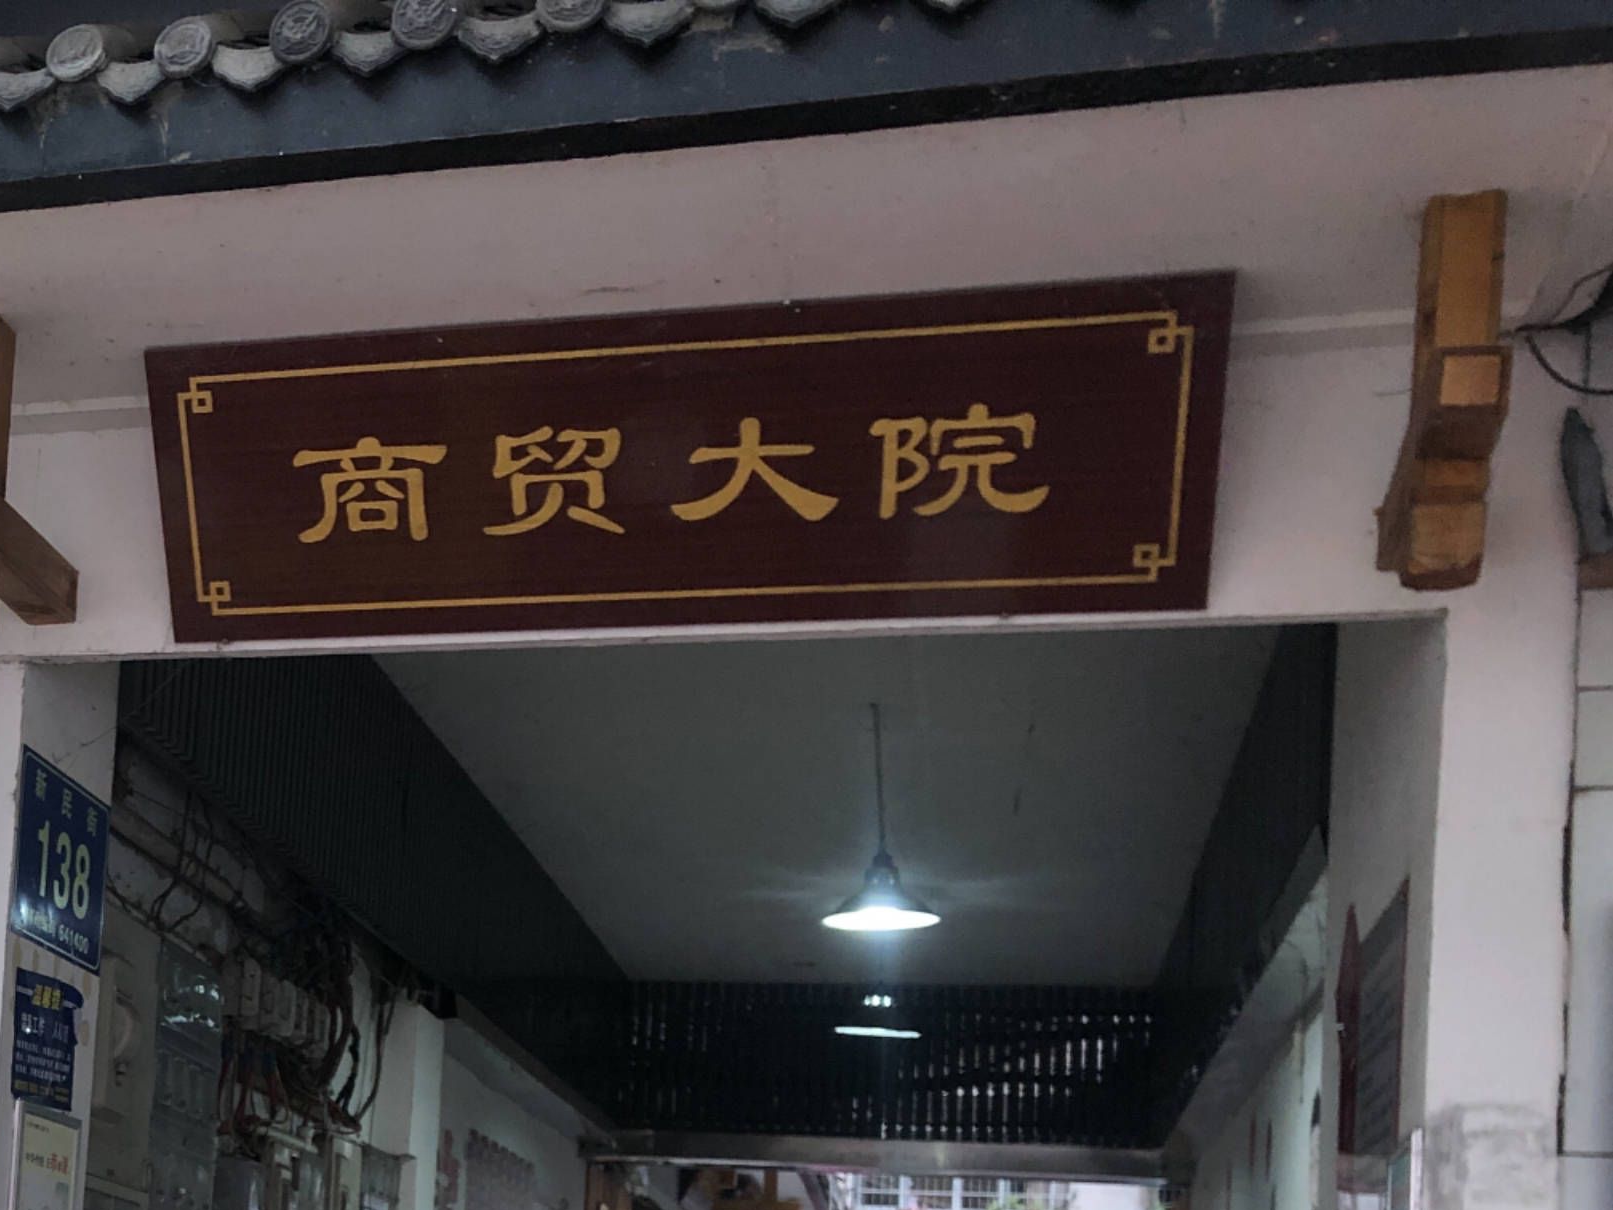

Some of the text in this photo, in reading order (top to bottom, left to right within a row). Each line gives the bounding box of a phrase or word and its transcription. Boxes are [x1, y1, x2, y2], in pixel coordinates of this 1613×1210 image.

[294, 404, 1049, 542] 商贸大院
[37, 819, 92, 920] 138
